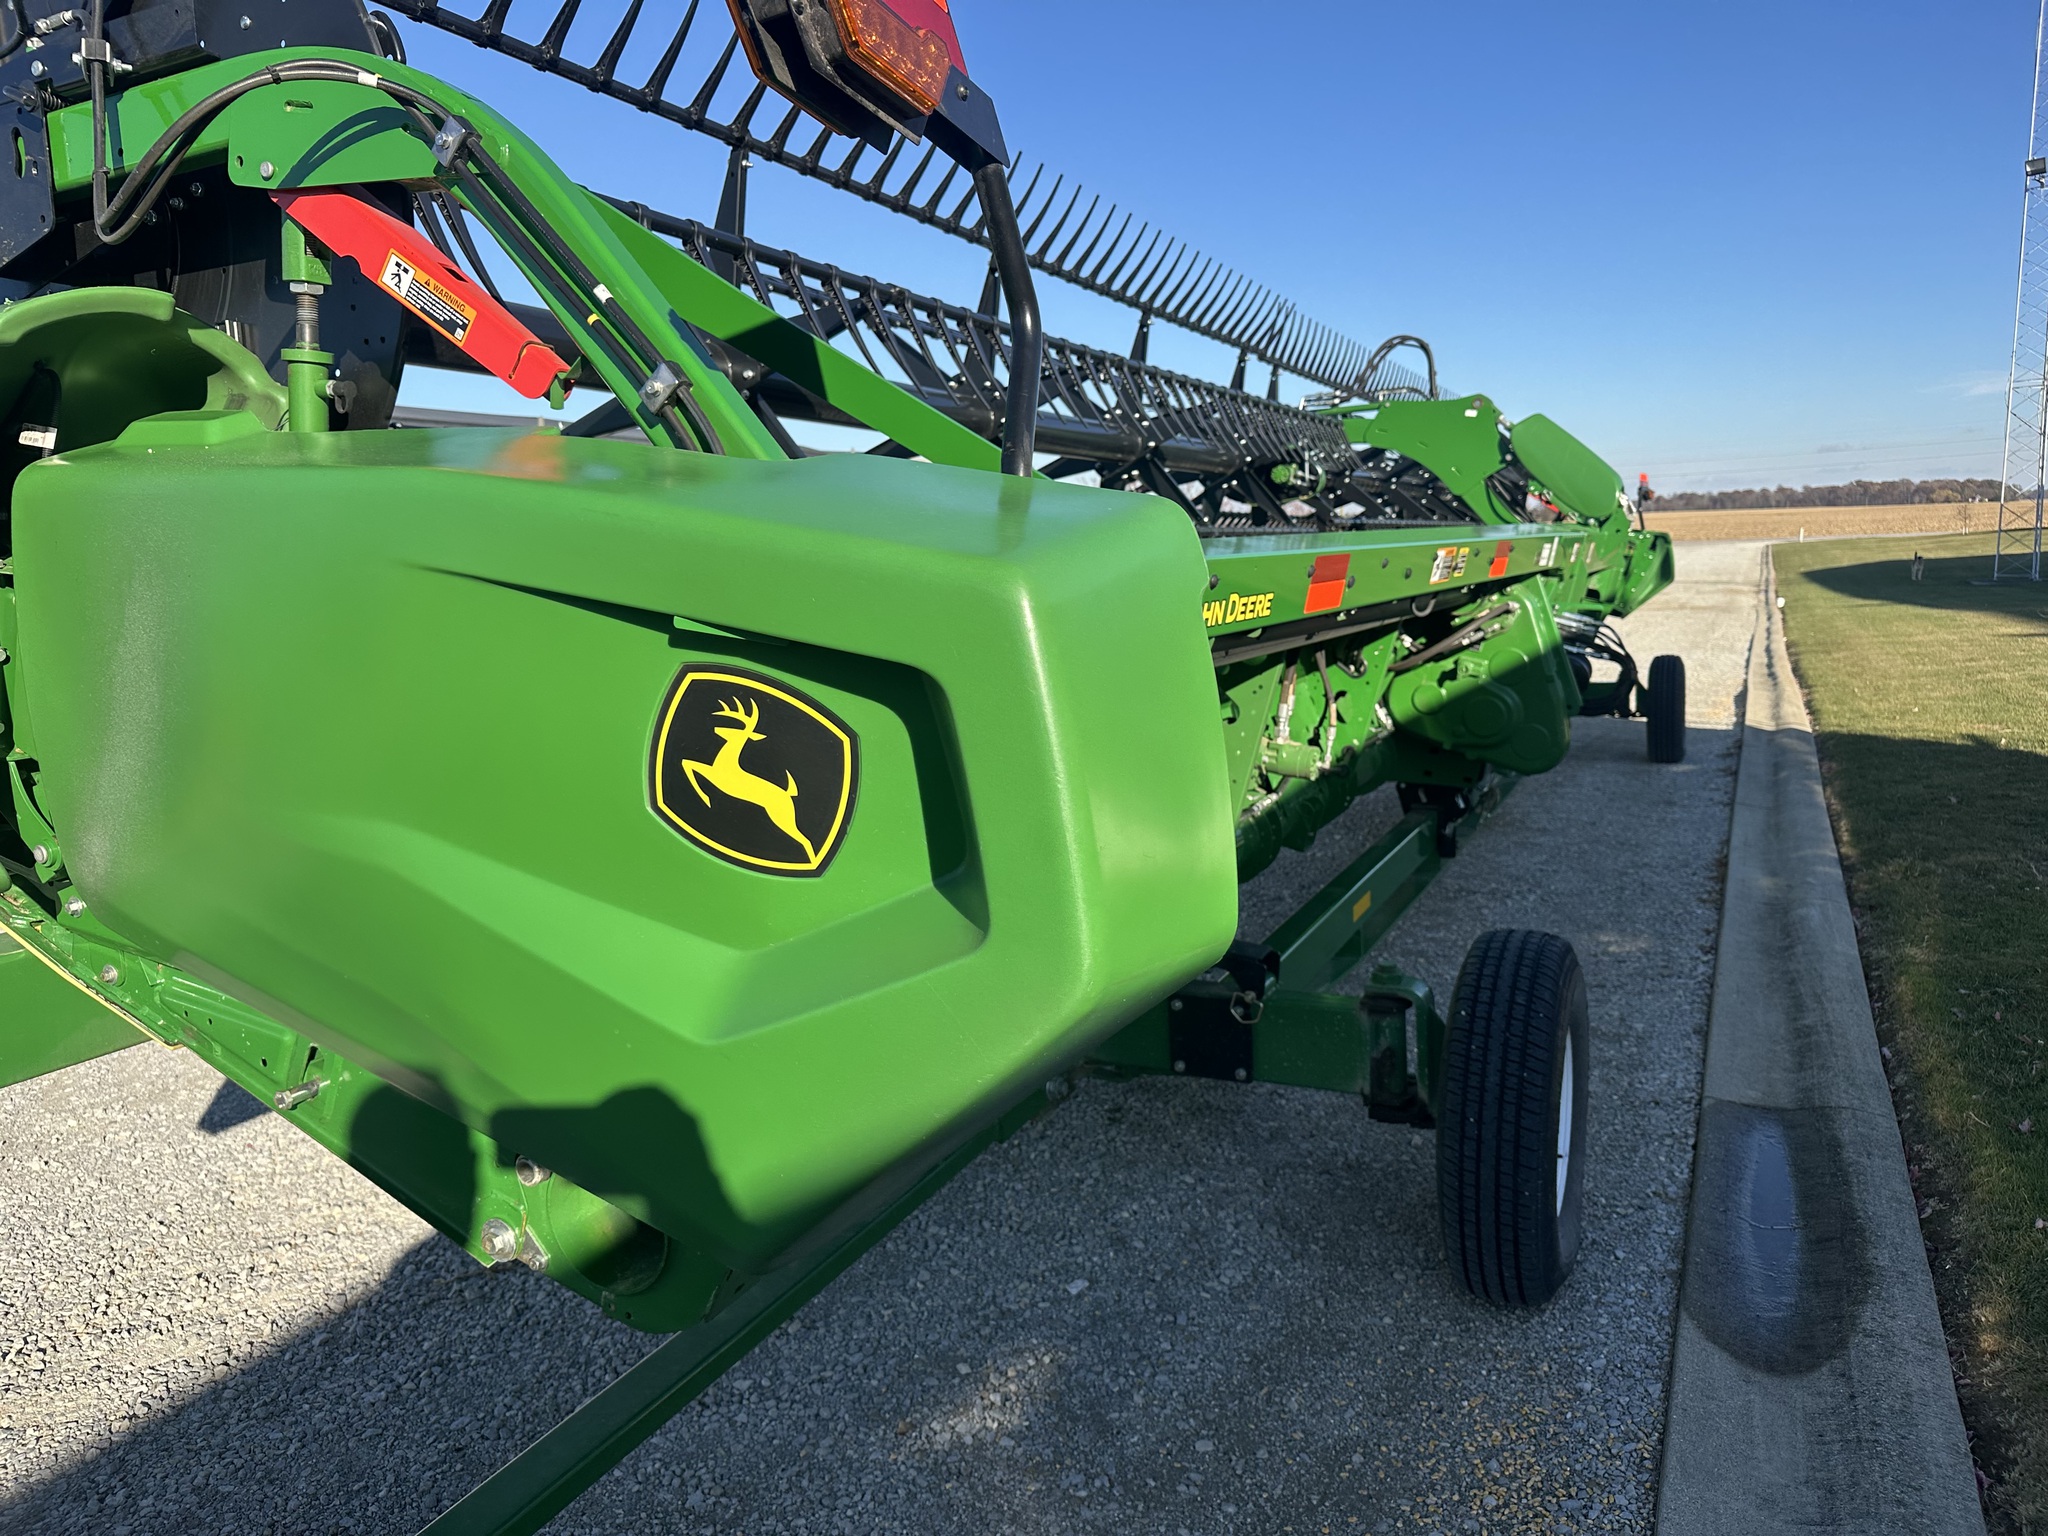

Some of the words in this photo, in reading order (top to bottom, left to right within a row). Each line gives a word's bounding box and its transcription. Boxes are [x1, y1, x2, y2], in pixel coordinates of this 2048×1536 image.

[432, 283, 466, 313] WARNING
[1202, 600, 1226, 627] HN
[1225, 593, 1274, 624] DEERE
